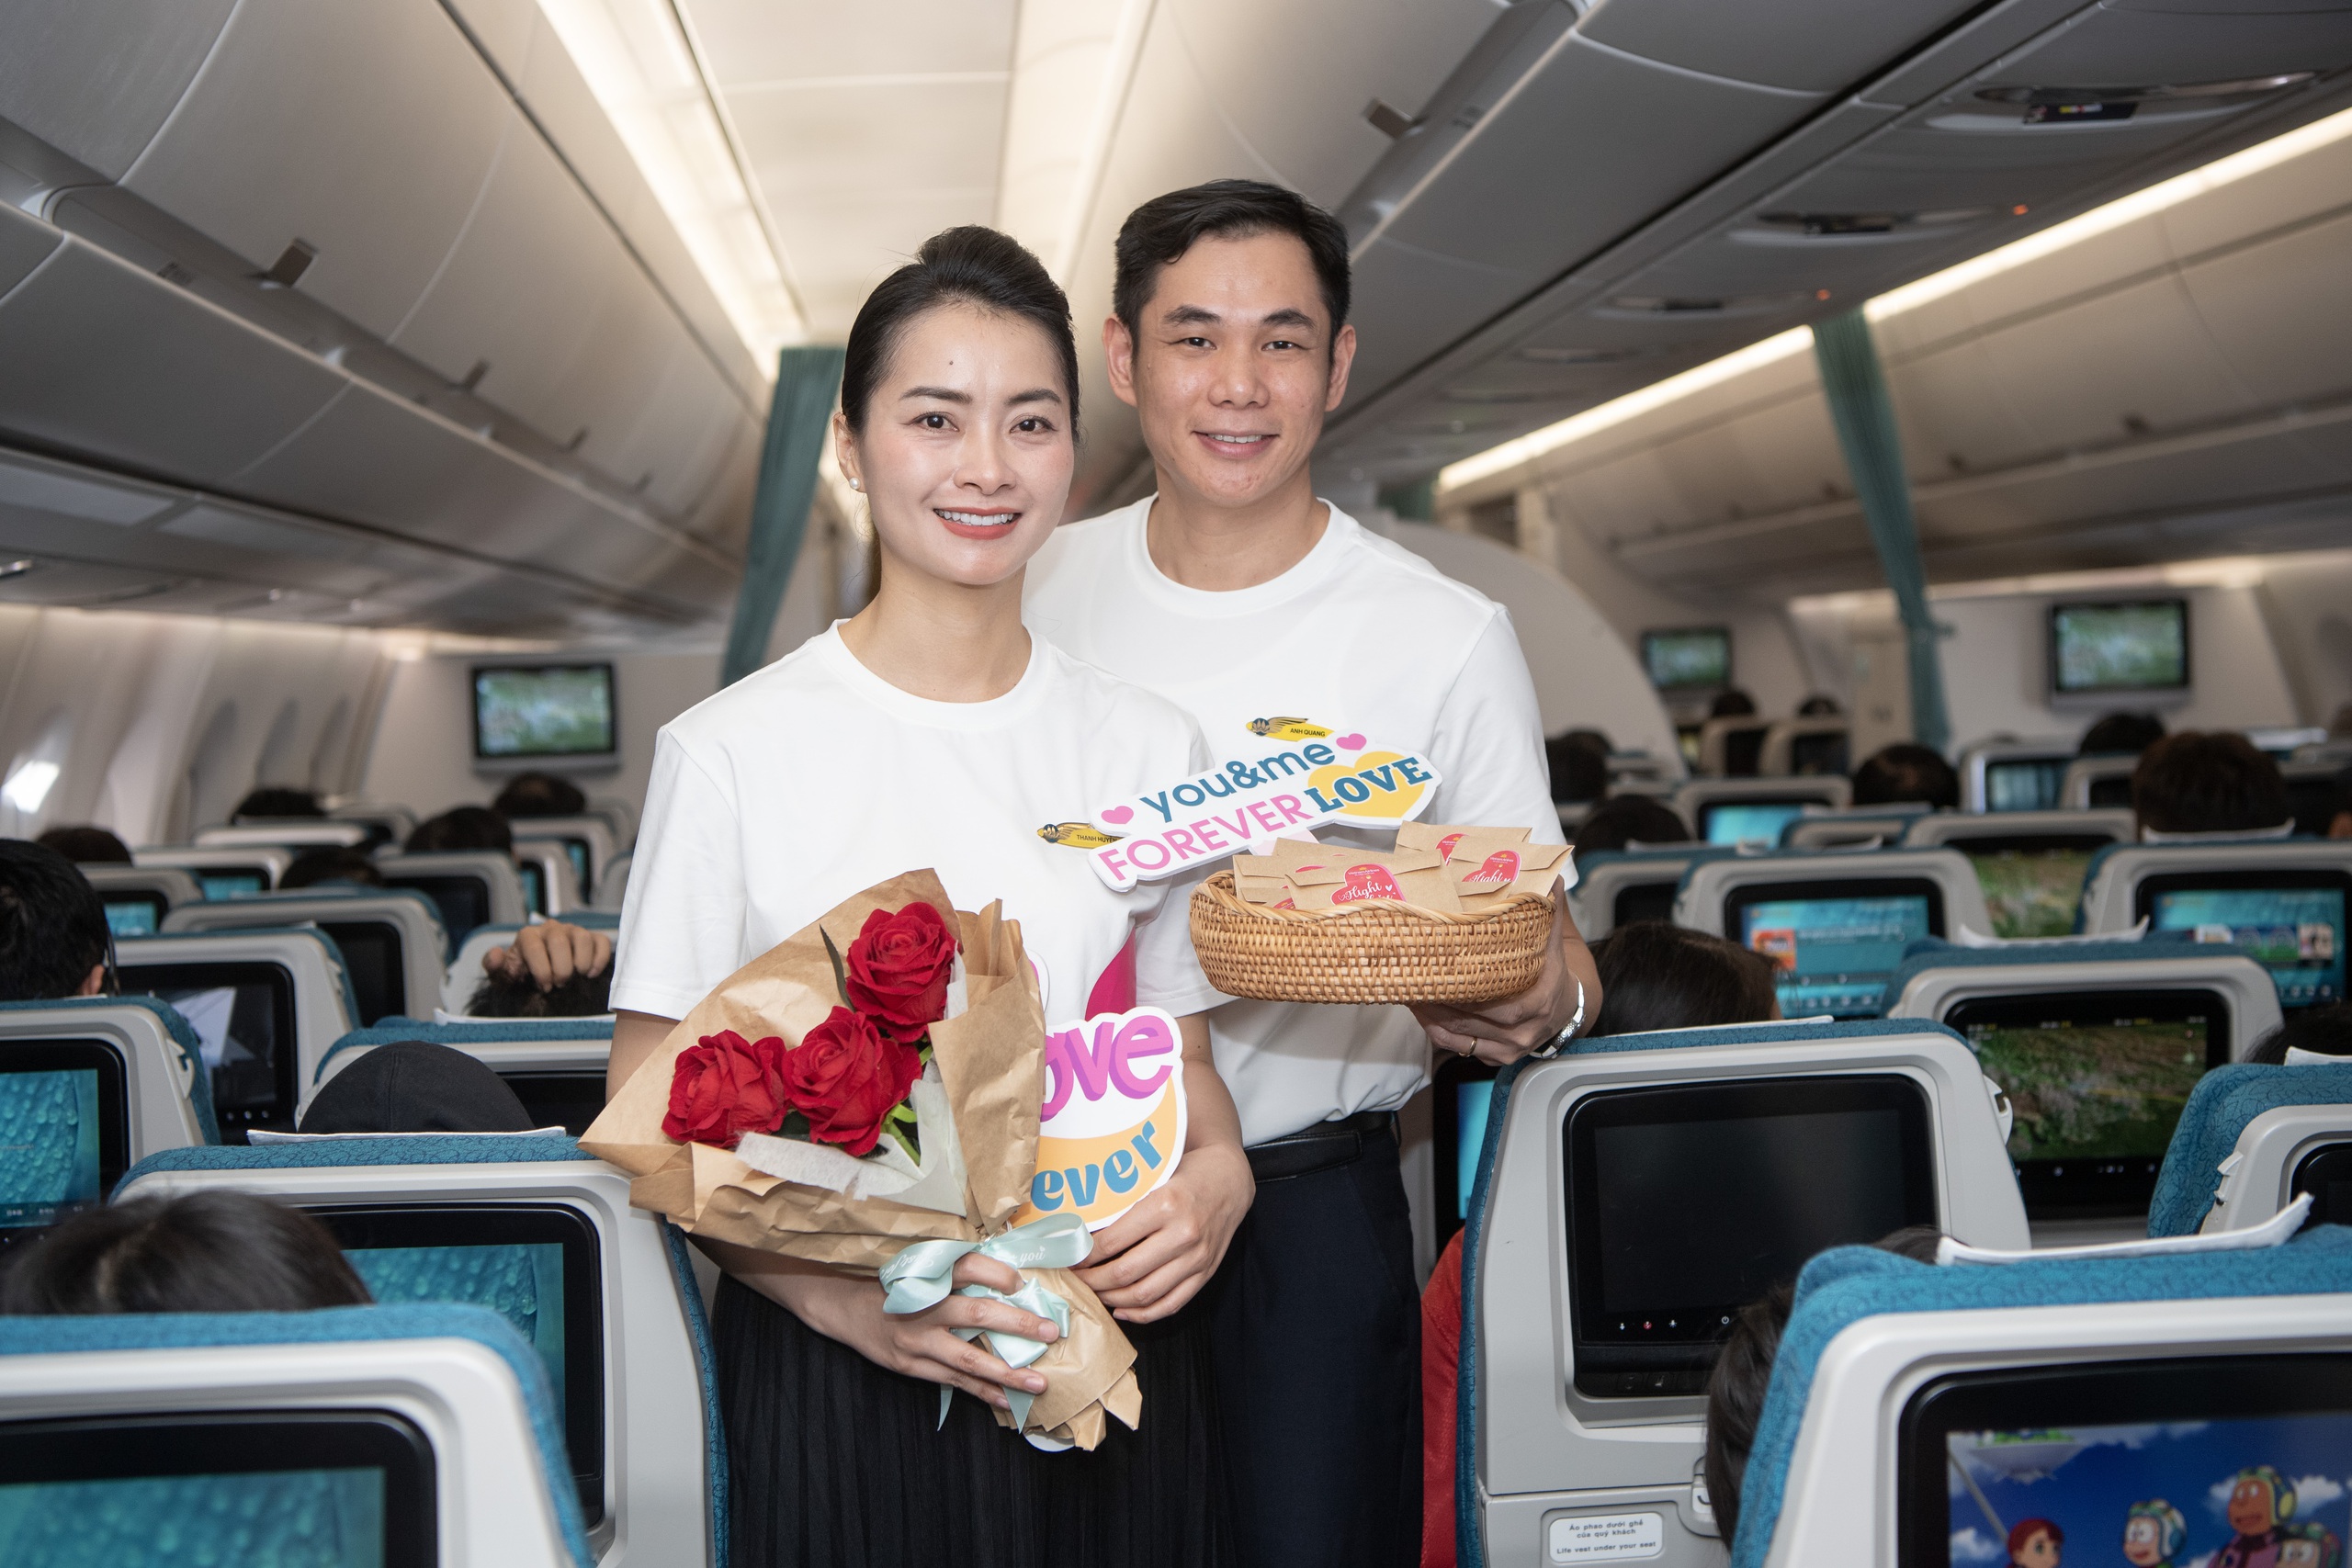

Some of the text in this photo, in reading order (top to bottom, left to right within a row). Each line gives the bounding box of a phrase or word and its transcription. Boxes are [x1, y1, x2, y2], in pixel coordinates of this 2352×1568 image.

[1139, 743, 1335, 824] you&me
[1077, 834, 1097, 842] THANH
[1097, 756, 1433, 881] FOREVER LOVE
[1040, 1015, 1174, 1122] ove
[1577, 1530, 1591, 1539] của
[1594, 1529, 1609, 1538] quý
[1583, 1523, 1603, 1531] phao
